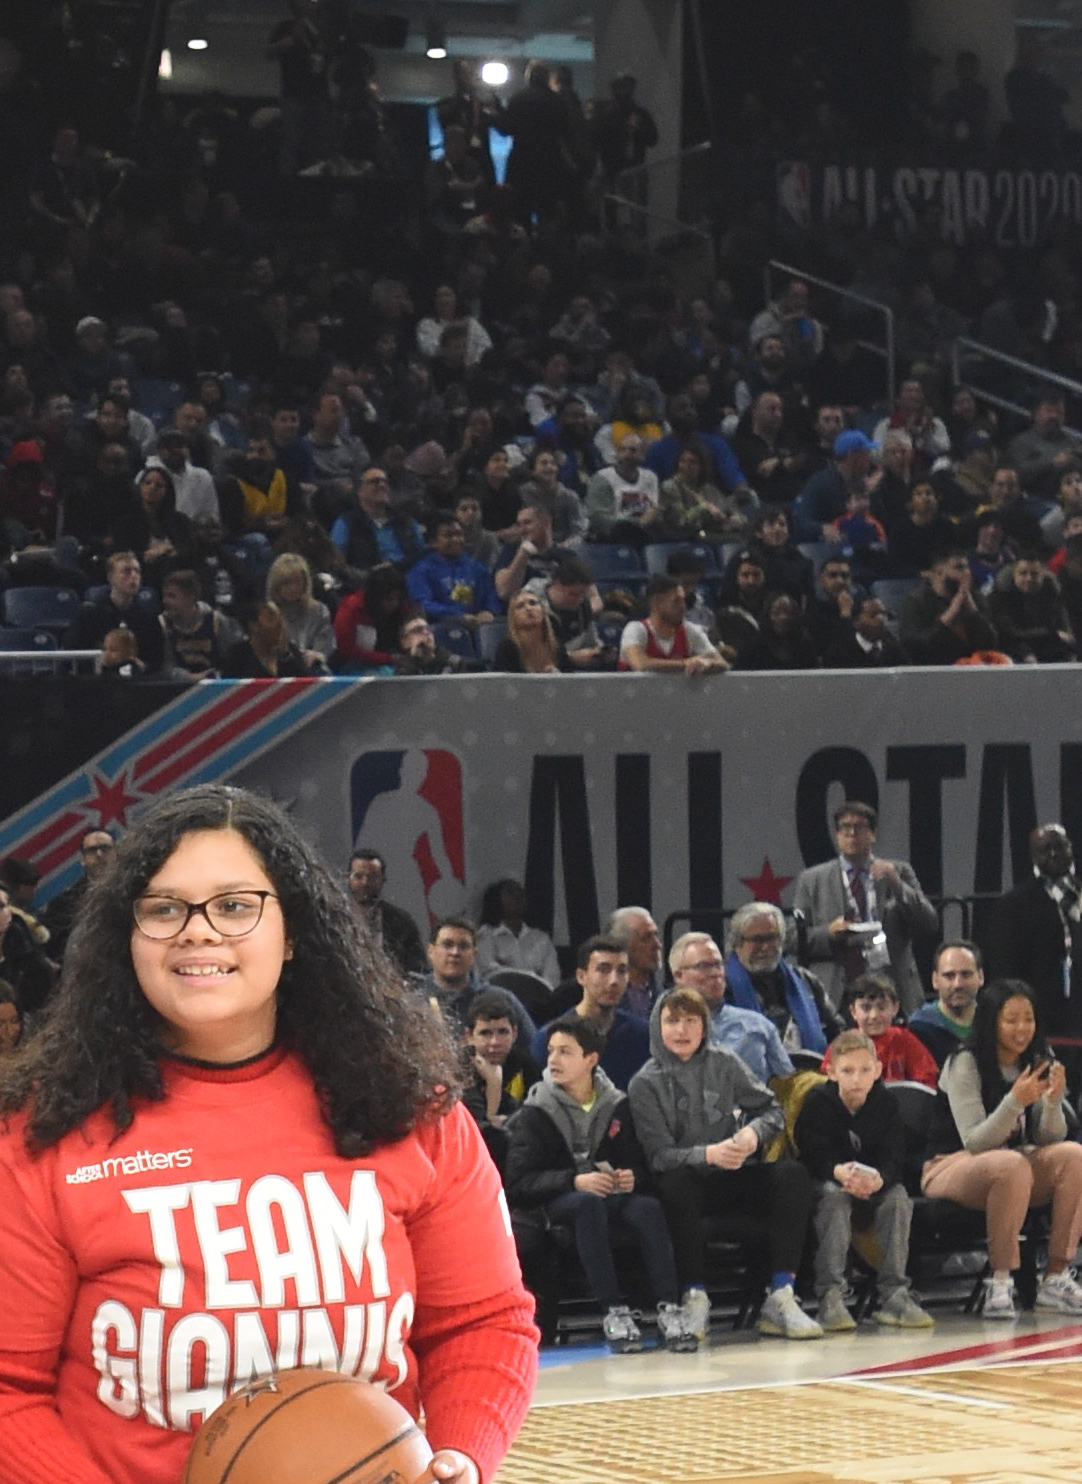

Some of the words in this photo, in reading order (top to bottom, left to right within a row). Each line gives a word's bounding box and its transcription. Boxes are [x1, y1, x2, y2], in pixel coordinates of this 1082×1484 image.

[795, 741, 1082, 897] STA
[102, 1149, 193, 1178] matters
[120, 1170, 391, 1309] TEAM
[92, 1291, 415, 1432] GIANNIS
